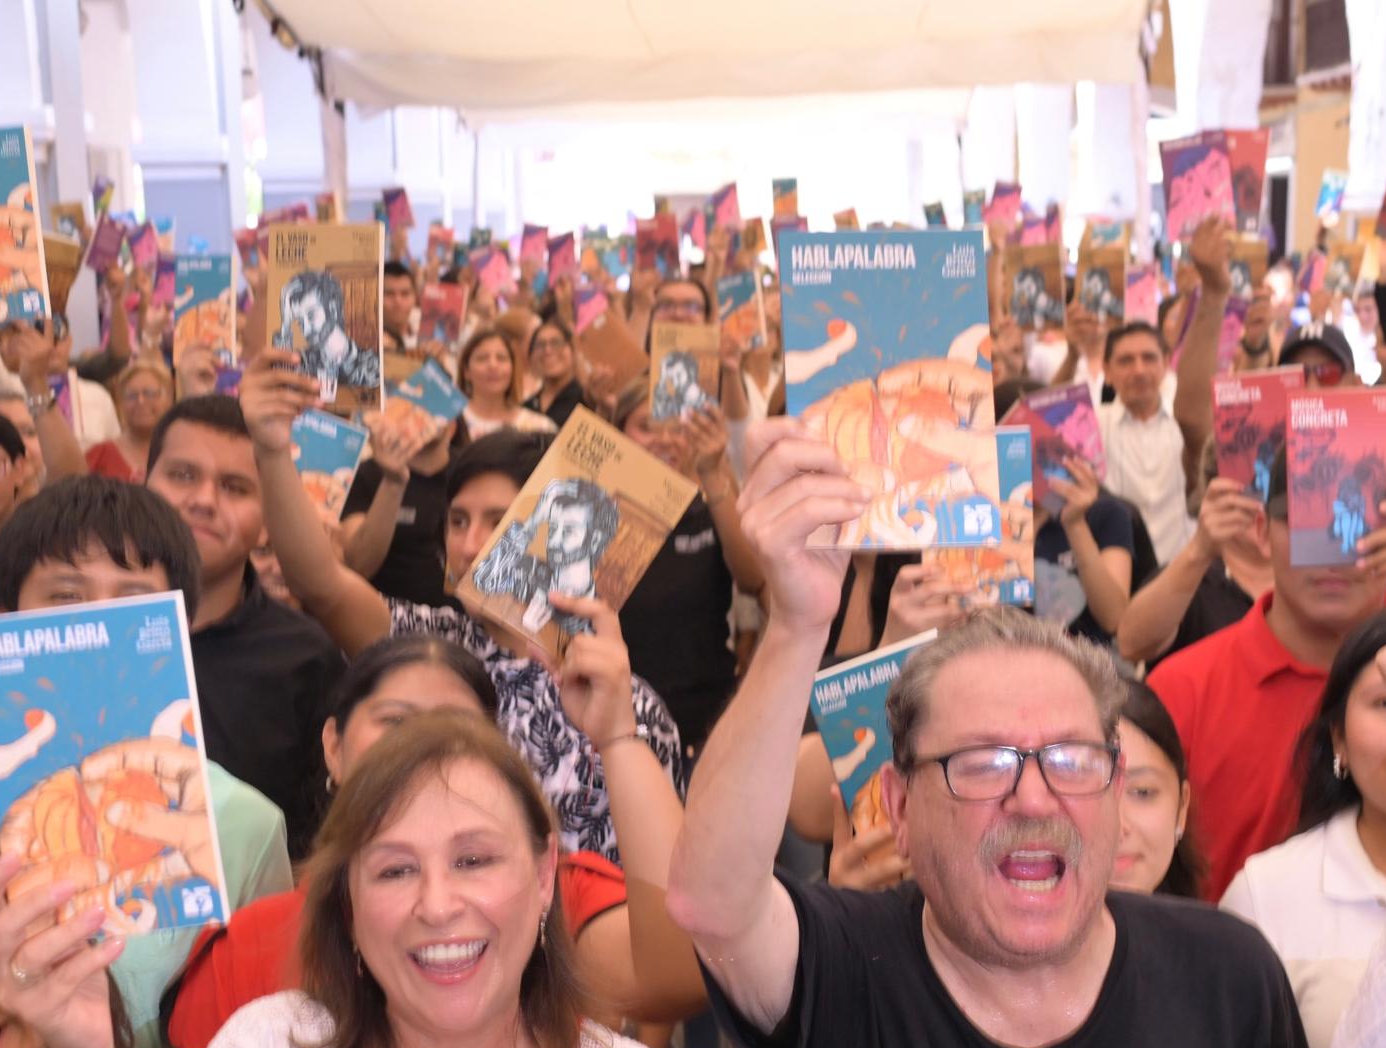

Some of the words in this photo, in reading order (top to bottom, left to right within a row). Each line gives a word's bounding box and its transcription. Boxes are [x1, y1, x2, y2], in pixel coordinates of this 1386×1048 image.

[791, 243, 916, 270] HABLAPALABRA
[1291, 408, 1349, 430] CONCRETA
[815, 660, 900, 708] HABLAPALABRA
